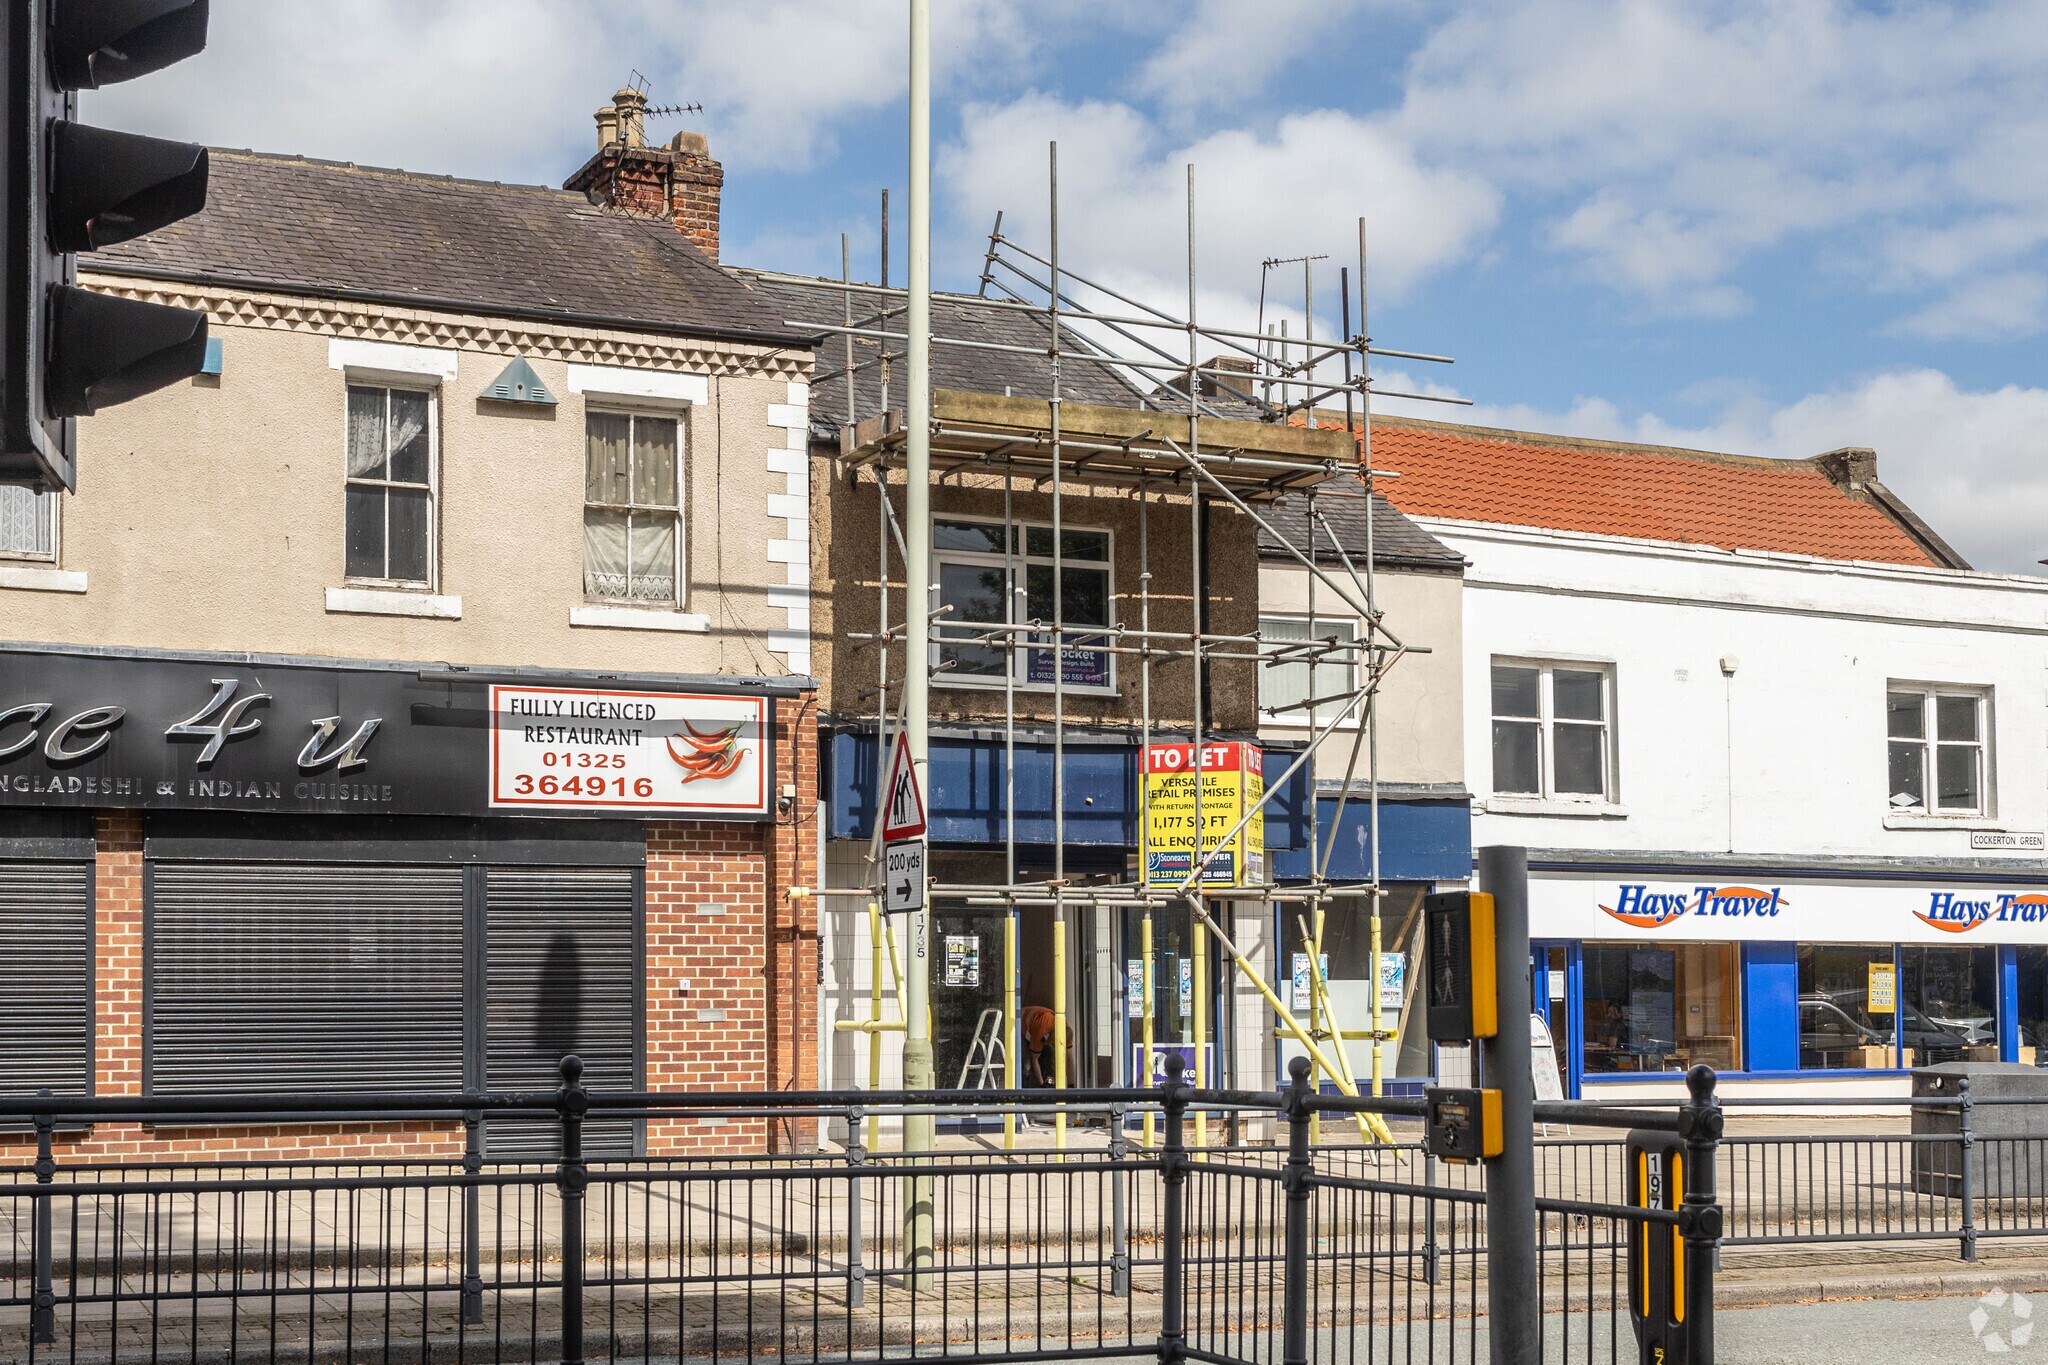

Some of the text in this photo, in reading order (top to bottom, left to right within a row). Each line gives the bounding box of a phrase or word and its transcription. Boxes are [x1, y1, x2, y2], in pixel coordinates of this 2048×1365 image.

[510, 698, 656, 721] FULLY LICENCED
[0, 678, 383, 769] ce 4 u
[525, 725, 643, 747] RESTAURANT
[542, 752, 626, 769] 01325
[1150, 747, 1229, 769] TO LET
[0, 774, 393, 802] NGLADESHI & INDIAN CUISINE
[514, 774, 654, 798] 364916
[1161, 777, 1217, 787] VERSAILE
[1183, 787, 1235, 798] PRMISES
[1154, 817, 1183, 830] 1,177
[1210, 816, 1228, 827] FT
[1973, 835, 2043, 846] COCKERTON GREEN
[889, 851, 920, 872] 200 yds
[1160, 853, 1191, 862] Stoneacre
[1161, 870, 1173, 878] 237
[1615, 884, 1781, 922] Hays Travel
[1927, 892, 2048, 928] Hays Trav
